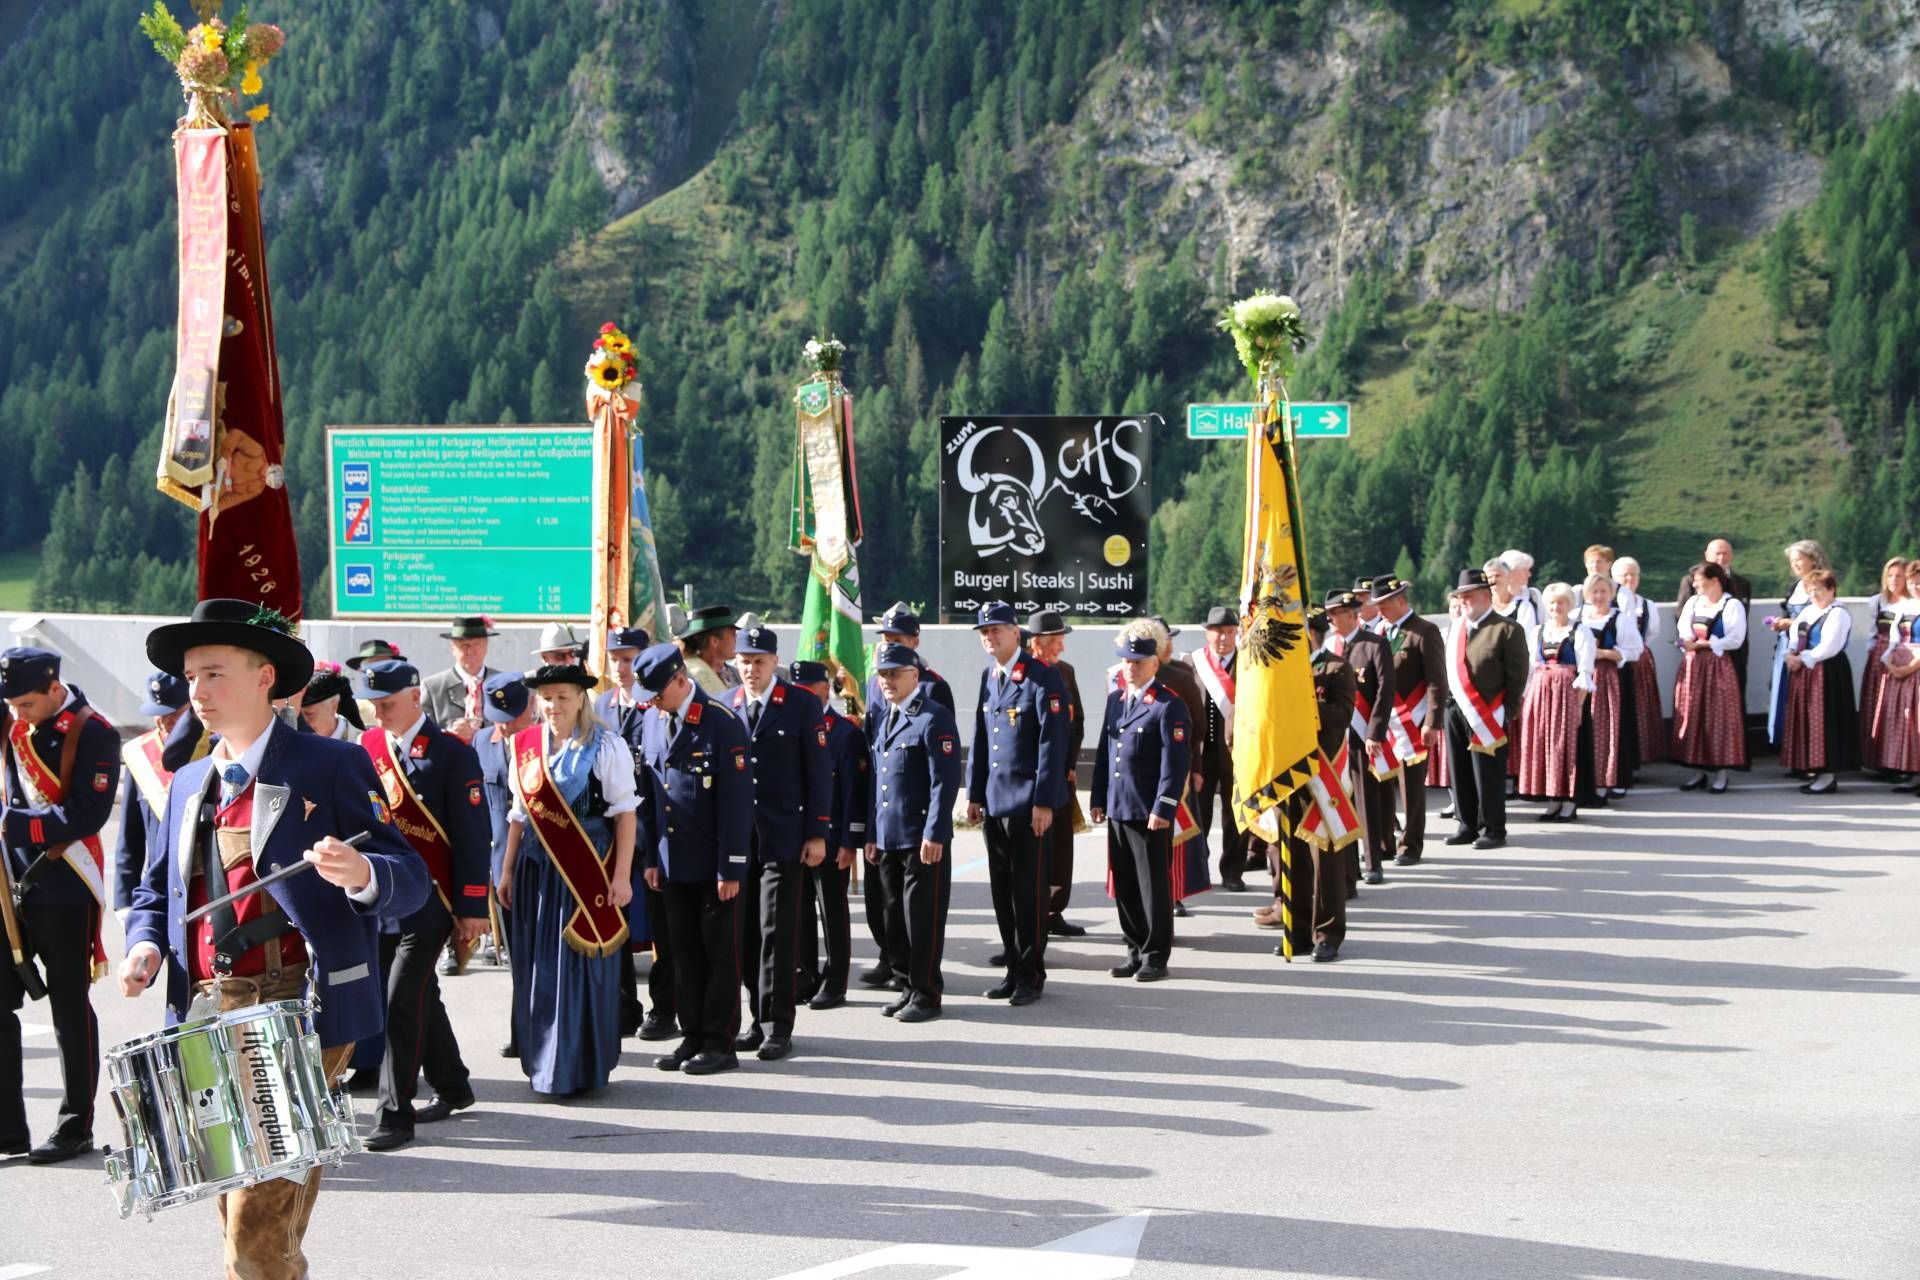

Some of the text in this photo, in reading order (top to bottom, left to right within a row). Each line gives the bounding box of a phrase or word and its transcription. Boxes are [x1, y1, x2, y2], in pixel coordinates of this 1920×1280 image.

[333, 434, 593, 449] Herzlich Willkommen in der Parkgarage Heiligenblut am Großglock
[347, 449, 382, 459] Welcome
[383, 449, 392, 459] to
[393, 449, 408, 459] the
[409, 449, 440, 461] parking
[441, 449, 470, 461] garage
[471, 447, 520, 460] Heiligenblut
[522, 449, 536, 458] am
[239, 544, 277, 593] 1926
[954, 570, 1010, 592] Burger
[1022, 571, 1076, 589] Steaks
[1088, 572, 1133, 590] Sushi
